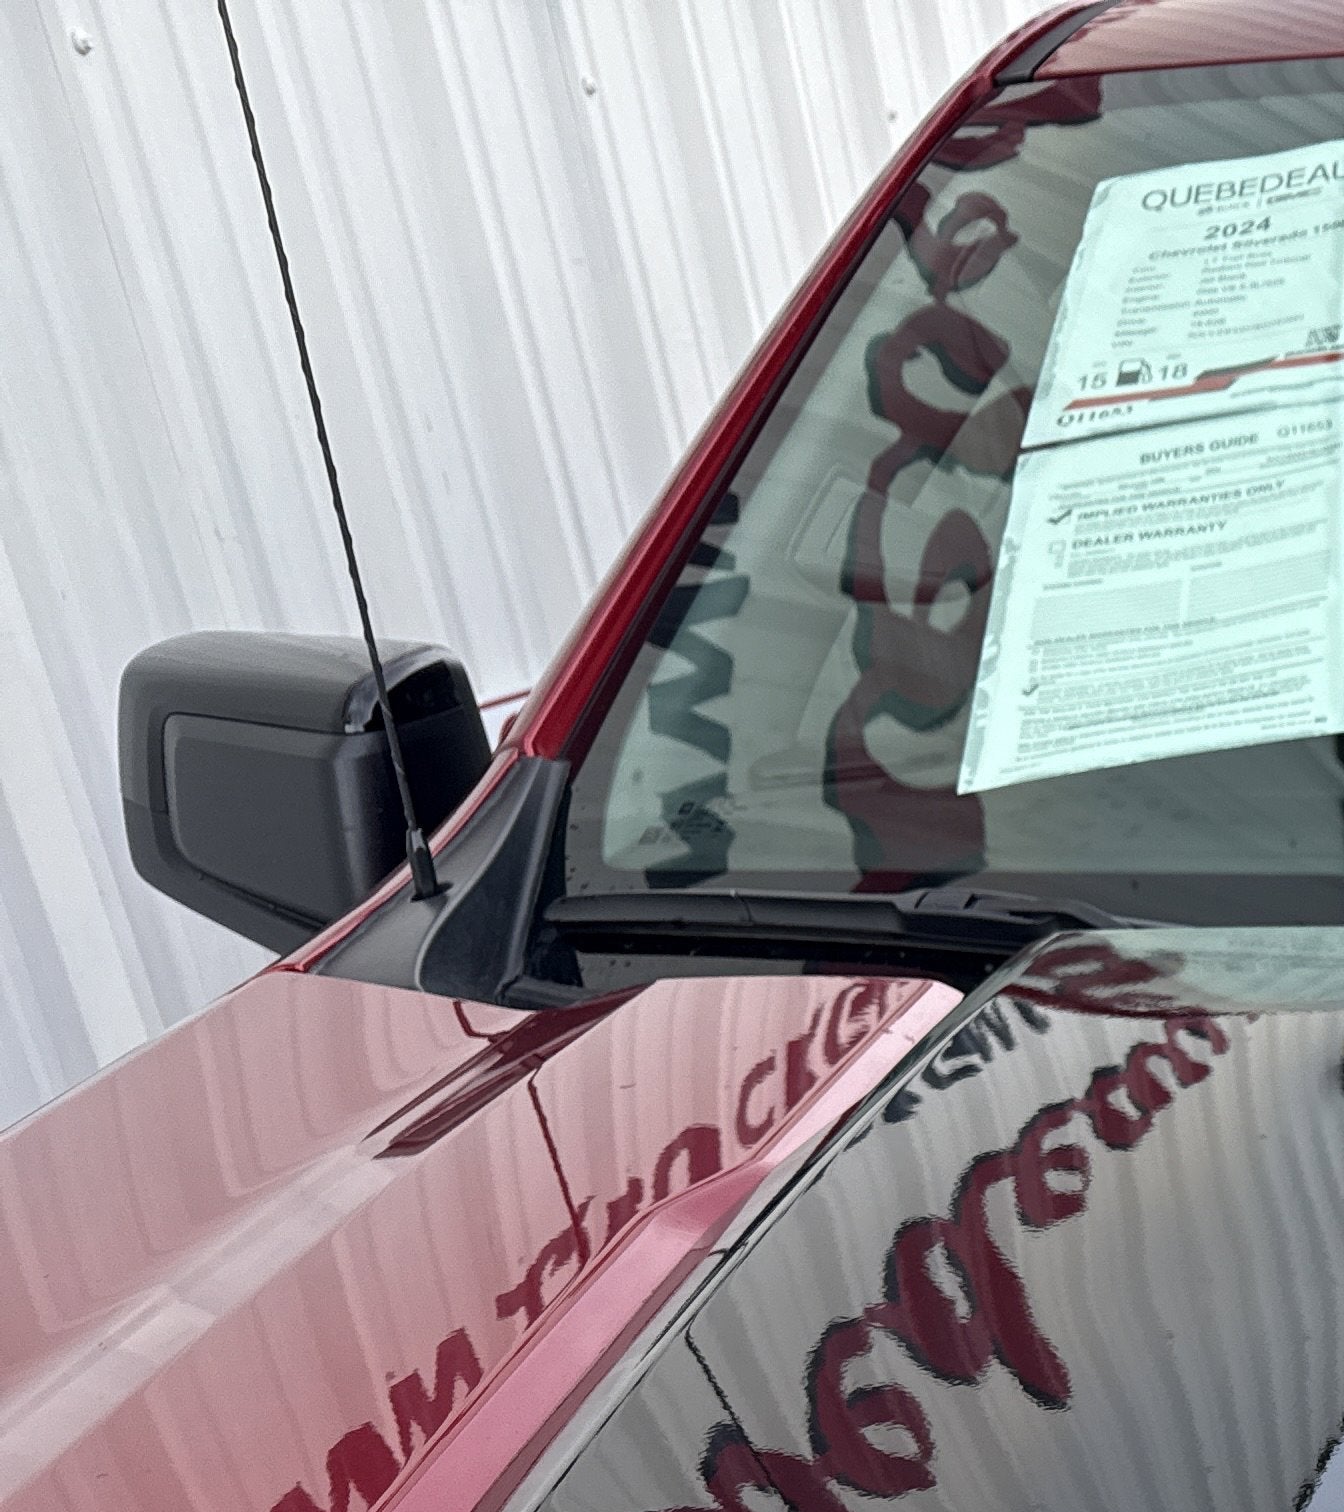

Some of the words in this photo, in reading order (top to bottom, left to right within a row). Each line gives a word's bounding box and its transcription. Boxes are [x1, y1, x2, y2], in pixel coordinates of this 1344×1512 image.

[1203, 215, 1272, 240] 2024
[1078, 373, 1108, 391] 15
[1158, 362, 1188, 380] 18
[1139, 443, 1205, 465] BUYERS
[1209, 432, 1260, 452] GUIDE
[1076, 503, 1139, 522] IMPLIED
[1140, 486, 1243, 512] WARRANTIES
[1245, 479, 1286, 498] ONLY
[1071, 532, 1135, 551] DEALER
[1137, 520, 1229, 543] WARRANTY
